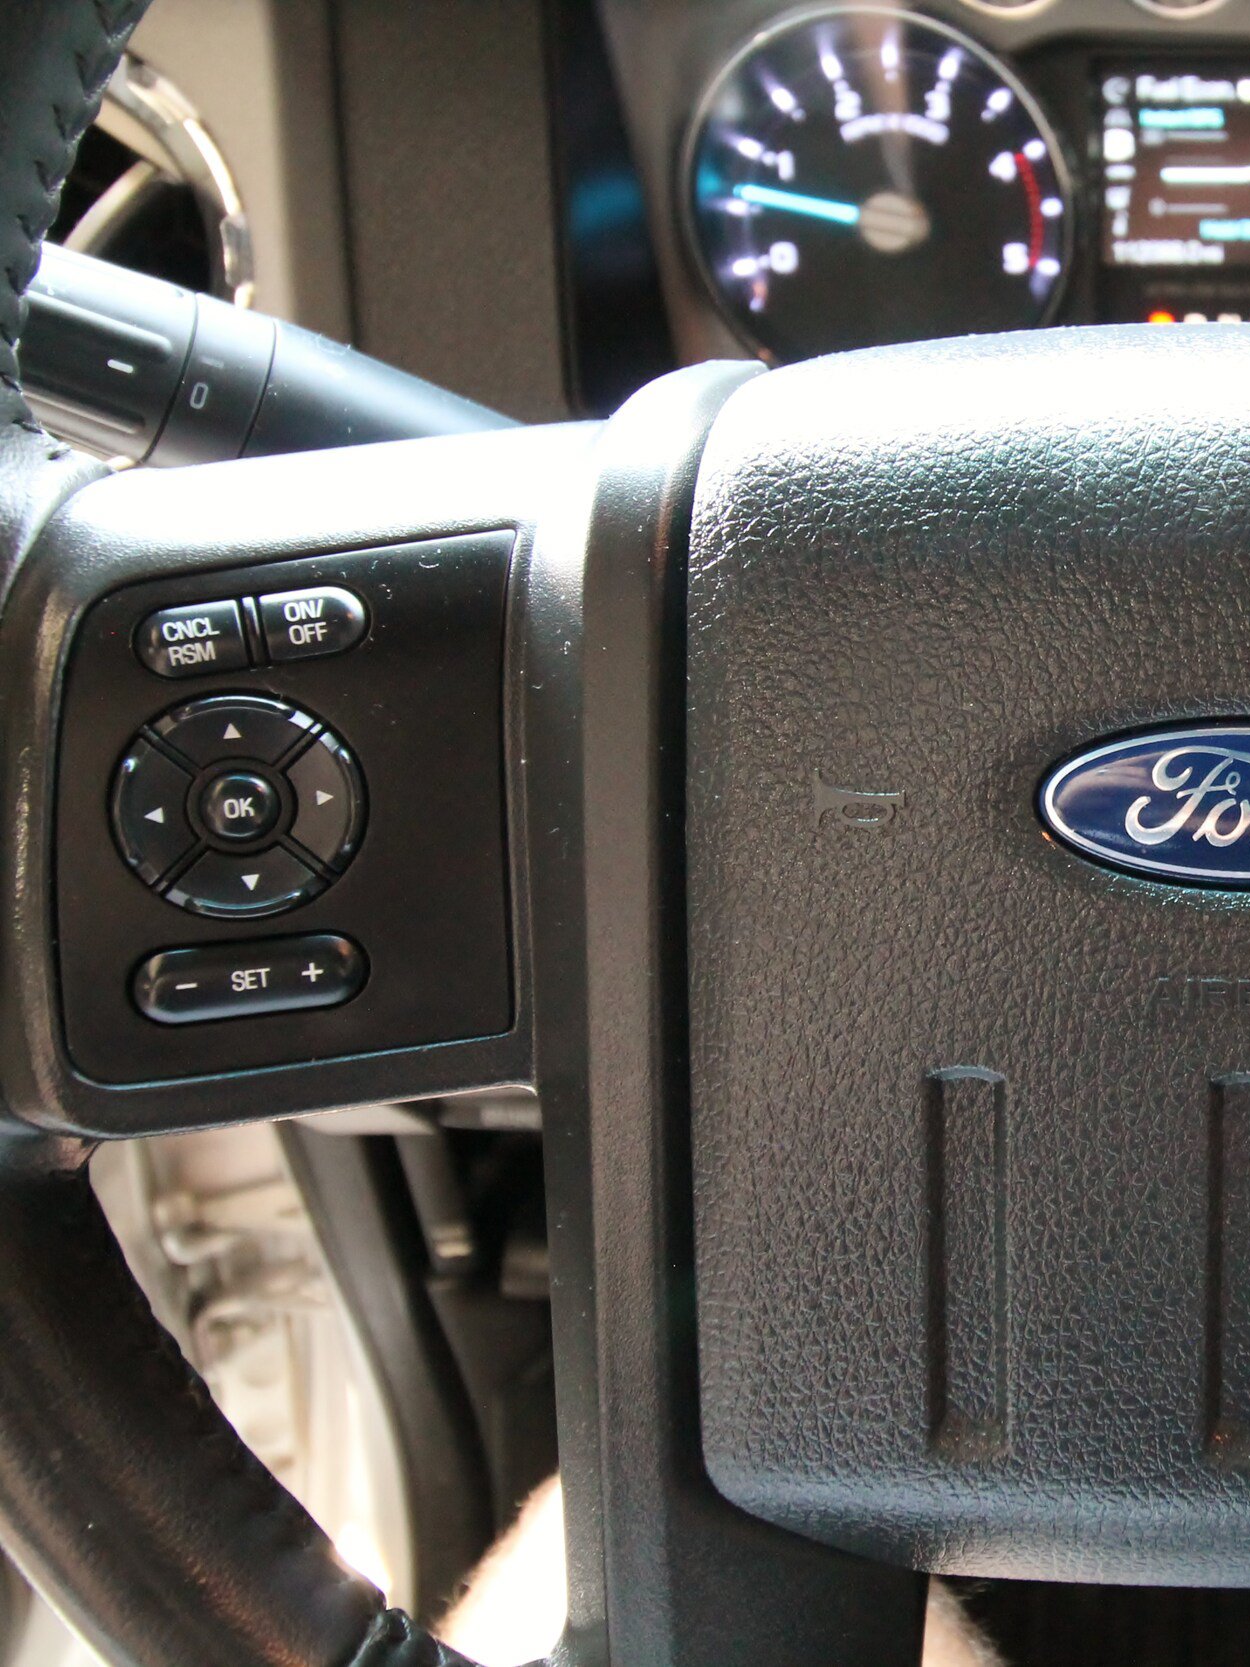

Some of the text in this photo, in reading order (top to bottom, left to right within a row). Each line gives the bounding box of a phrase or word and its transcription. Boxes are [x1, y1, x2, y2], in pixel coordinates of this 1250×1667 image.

[284, 598, 323, 622] ON/
[162, 617, 220, 642] CNCL
[288, 622, 328, 646] OFF
[168, 641, 216, 667] RSM
[223, 797, 255, 819] OK
[231, 968, 270, 992] SET
